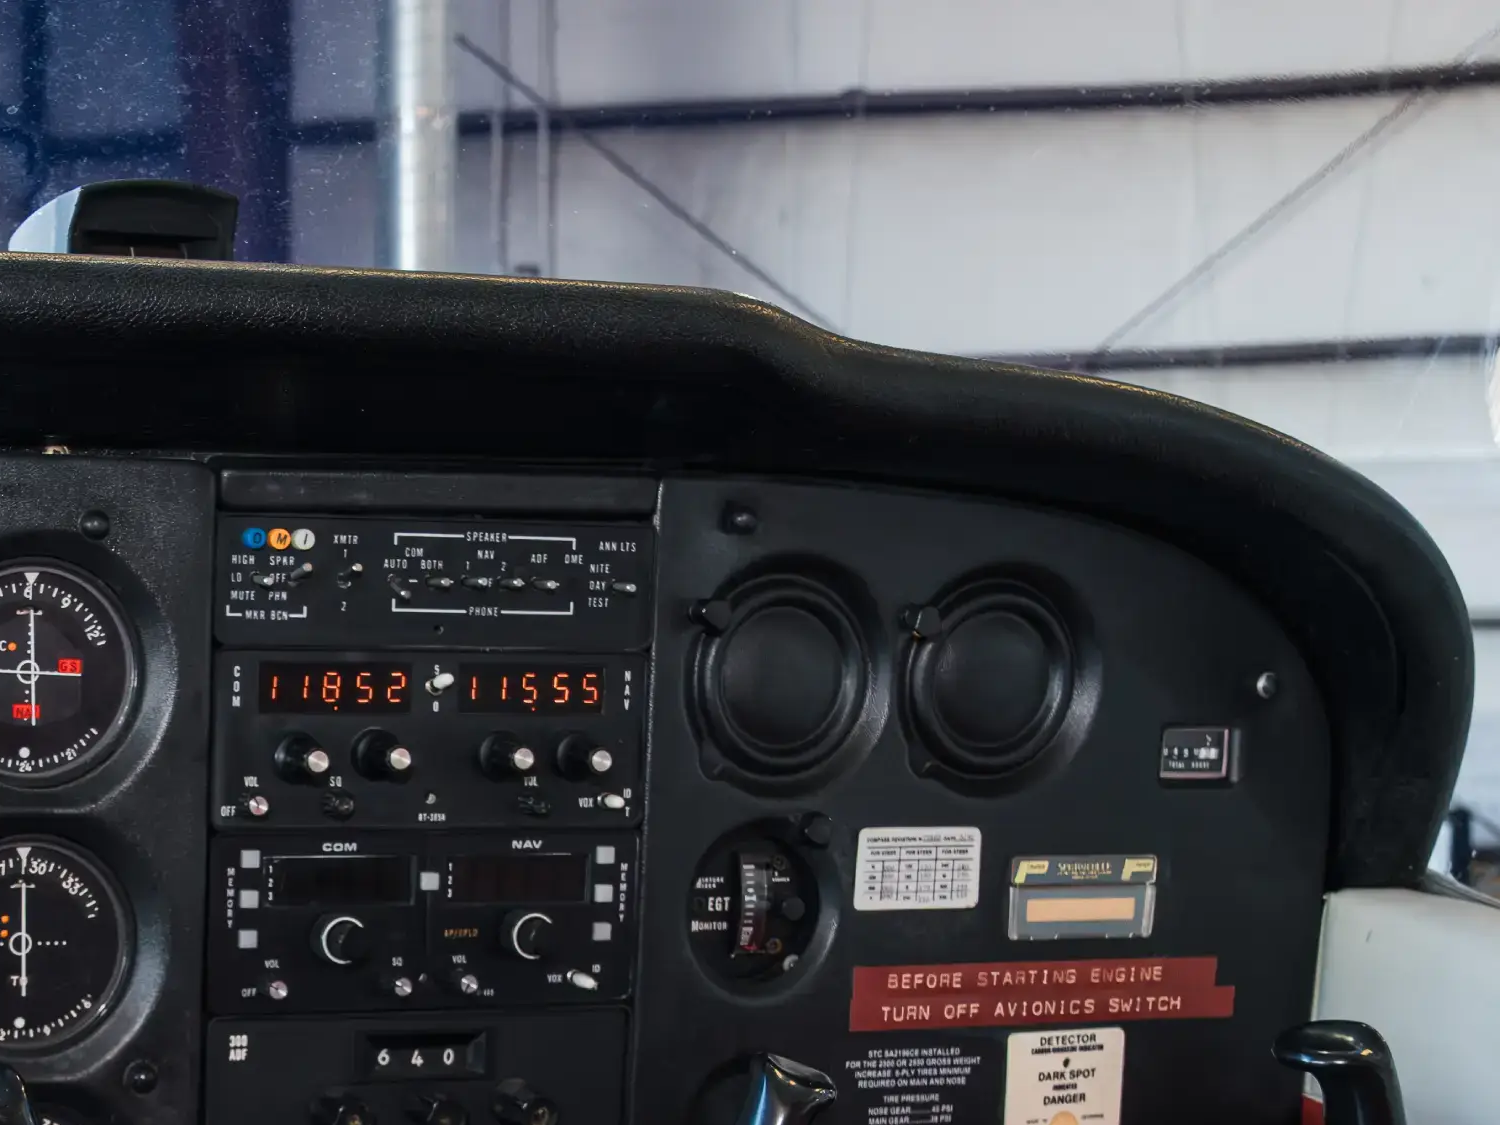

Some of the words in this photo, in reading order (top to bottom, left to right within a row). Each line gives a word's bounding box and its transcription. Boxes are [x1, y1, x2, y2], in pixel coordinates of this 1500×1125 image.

[333, 535, 359, 545] XMTR
[466, 532, 507, 542] SPEAKER
[599, 541, 617, 552] ANN
[620, 542, 636, 552] LTS
[405, 548, 424, 557] COM
[477, 550, 495, 560] NAV
[231, 555, 255, 565] HIGH
[269, 556, 294, 566] SPKR
[384, 559, 408, 569] AUTO
[589, 564, 610, 574] NITE
[230, 591, 255, 600] MUTE
[588, 598, 609, 608] TEST
[245, 610, 265, 620] MKR
[270, 611, 288, 620] BCN
[468, 606, 499, 617] PHONE
[322, 843, 358, 851] COM
[512, 840, 542, 849] NAV
[619, 863, 628, 922] MEMORY
[708, 896, 731, 911] EGT
[887, 972, 962, 989] BEFORE
[977, 968, 1076, 987] STARTING
[1091, 966, 1163, 983] ENGINE
[882, 1004, 930, 1022] TURN
[944, 1003, 980, 1020] OFF
[994, 999, 1095, 1017] AVIONICS
[1108, 995, 1182, 1013] SWITCH
[1040, 1033, 1097, 1046] DETECTOR
[921, 1047, 960, 1057] INSTALLED
[846, 1061, 861, 1069] FOR
[862, 1061, 877, 1069] THE
[896, 1060, 907, 1068] OR
[926, 1058, 951, 1067] GROSS
[953, 1056, 981, 1066] WEIGHT
[917, 1068, 938, 1077] TIRES
[939, 1067, 971, 1076] MINIMUM
[1038, 1072, 1066, 1082] DARK
[1069, 1068, 1096, 1080] SPOT
[858, 1079, 896, 1088] REQUIRED
[898, 1079, 908, 1088] ON
[910, 1078, 928, 1086] MAIN
[929, 1077, 945, 1086] AND
[946, 1076, 967, 1085] NOSE
[883, 1094, 900, 1103] TIRE
[901, 1093, 940, 1103] PRESSURE
[1043, 1092, 1086, 1106] DANGER
[868, 1108, 888, 1117] NOSE
[868, 1117, 888, 1125] MAIN
